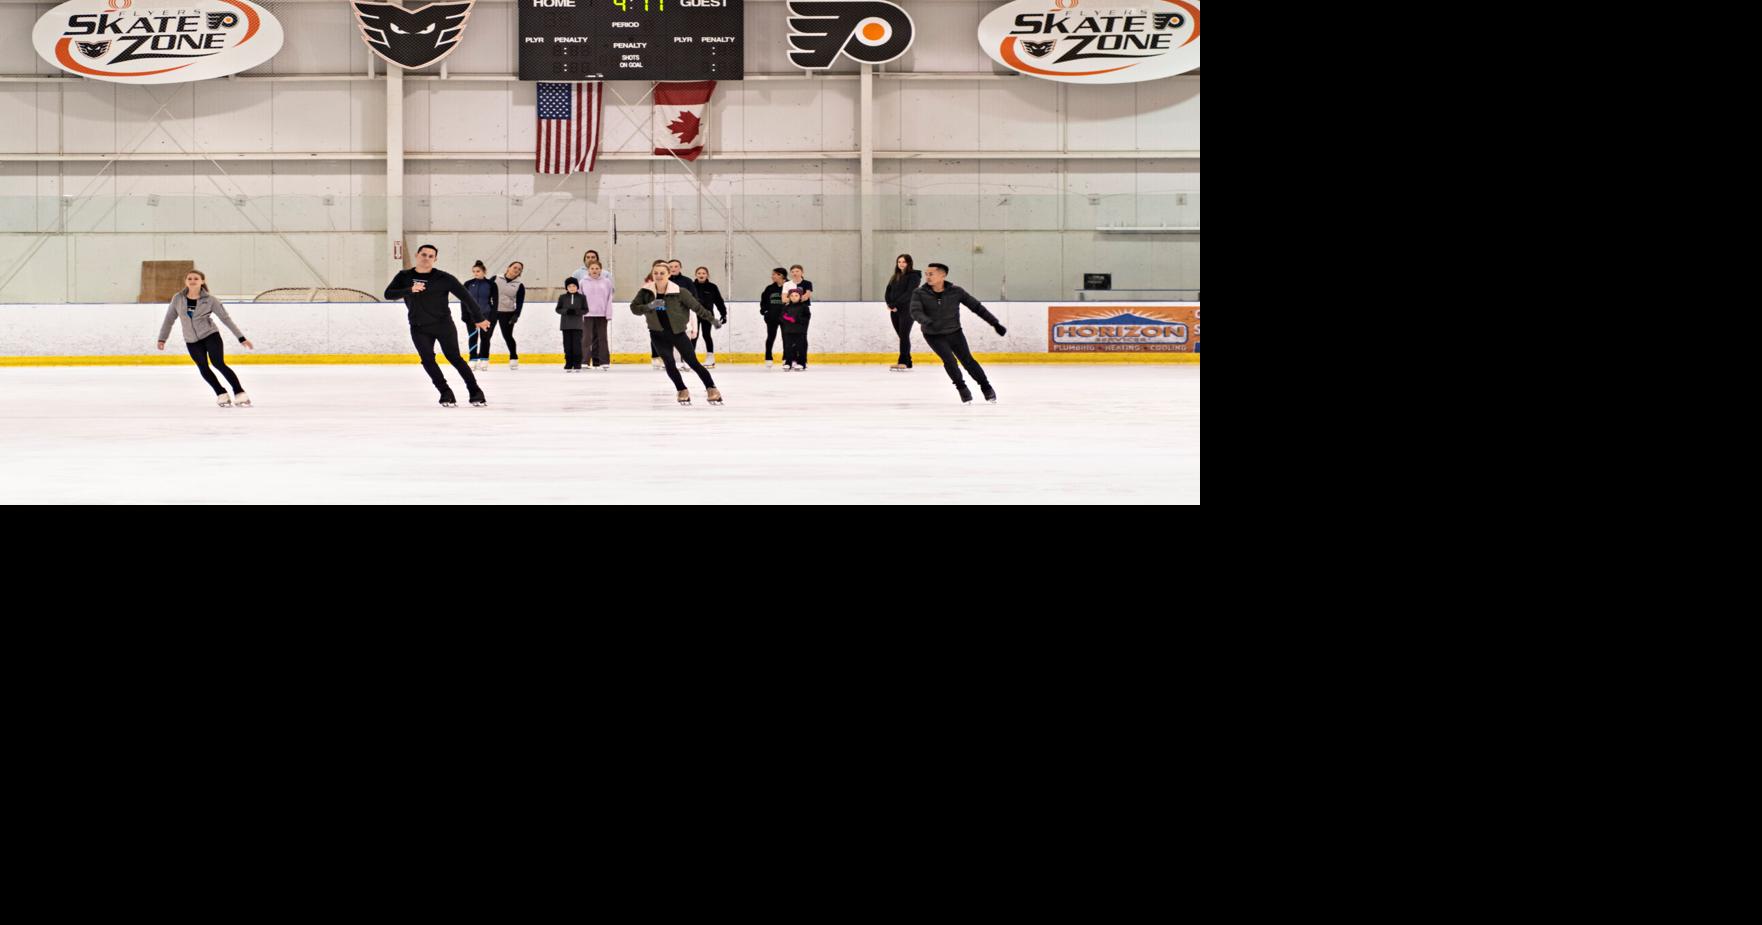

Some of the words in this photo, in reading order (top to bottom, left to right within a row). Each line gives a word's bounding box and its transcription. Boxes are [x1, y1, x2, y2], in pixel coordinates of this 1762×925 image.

[118, 9, 201, 17] FLYERS
[1009, 13, 1147, 35] SKATE
[1065, 9, 1148, 17] FLYERS
[63, 14, 200, 36] SKATE
[106, 33, 227, 65] ZONE
[1052, 33, 1173, 64] ZONE
[1056, 326, 1185, 338] HORIZON
